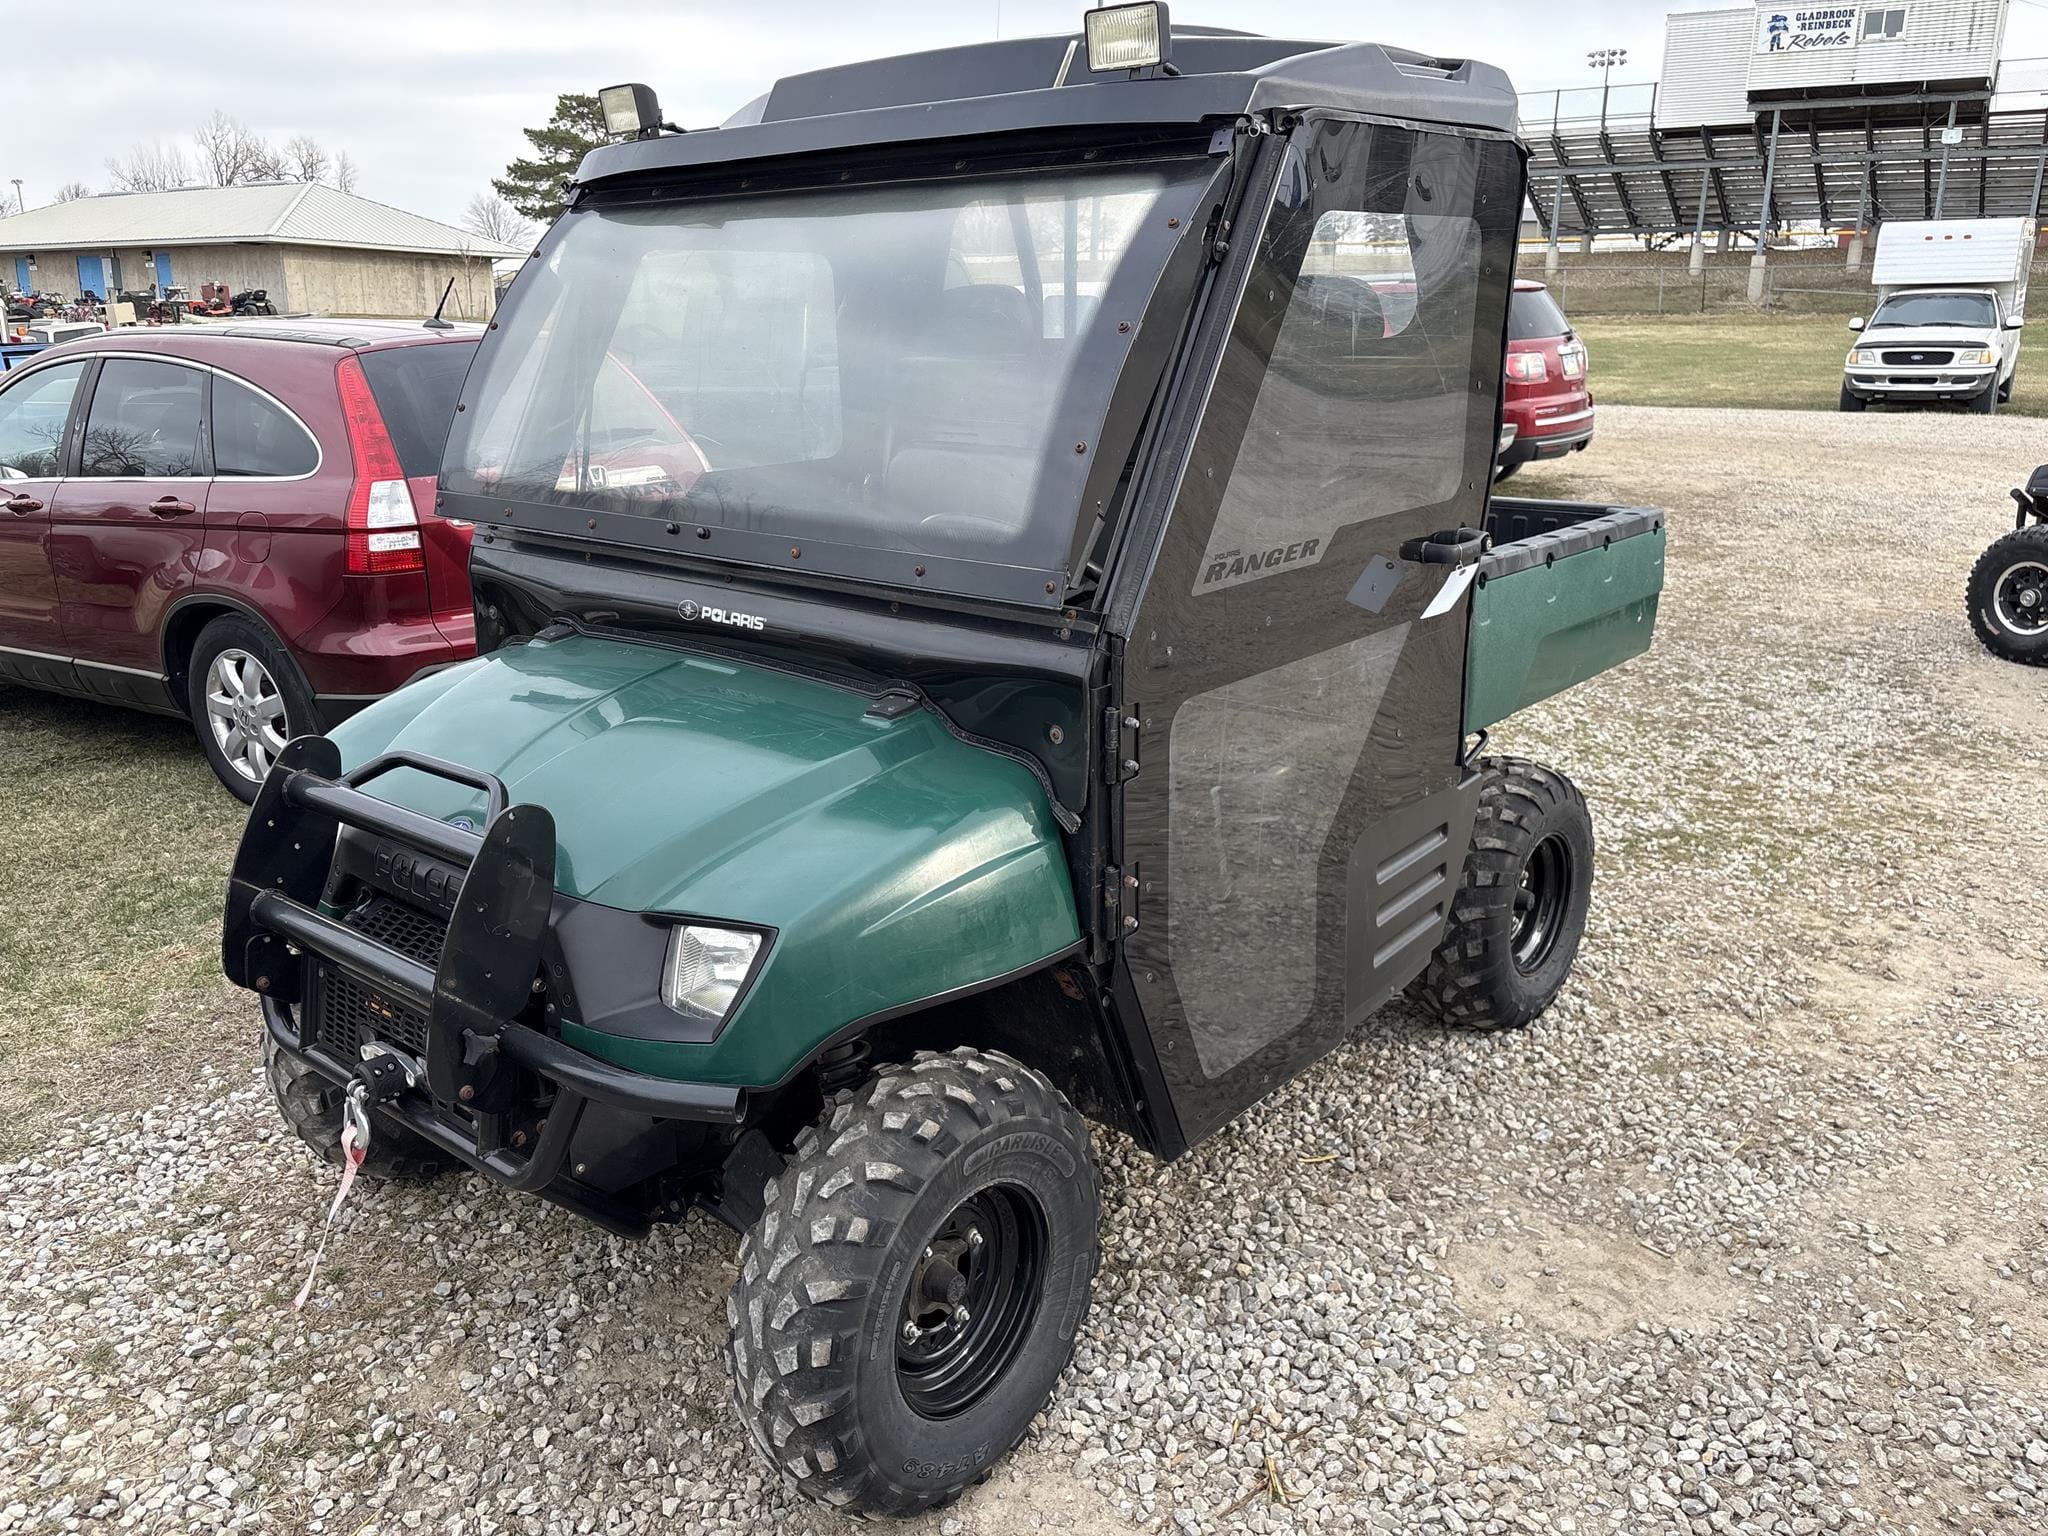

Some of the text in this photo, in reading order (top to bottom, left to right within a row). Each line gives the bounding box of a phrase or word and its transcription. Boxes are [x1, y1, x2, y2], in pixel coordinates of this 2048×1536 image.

[1796, 9, 1856, 22] GLADBROOK
[1786, 31, 1851, 50] Rebels
[1203, 538, 1320, 584] RANGER
[701, 606, 765, 631] POLARIS
